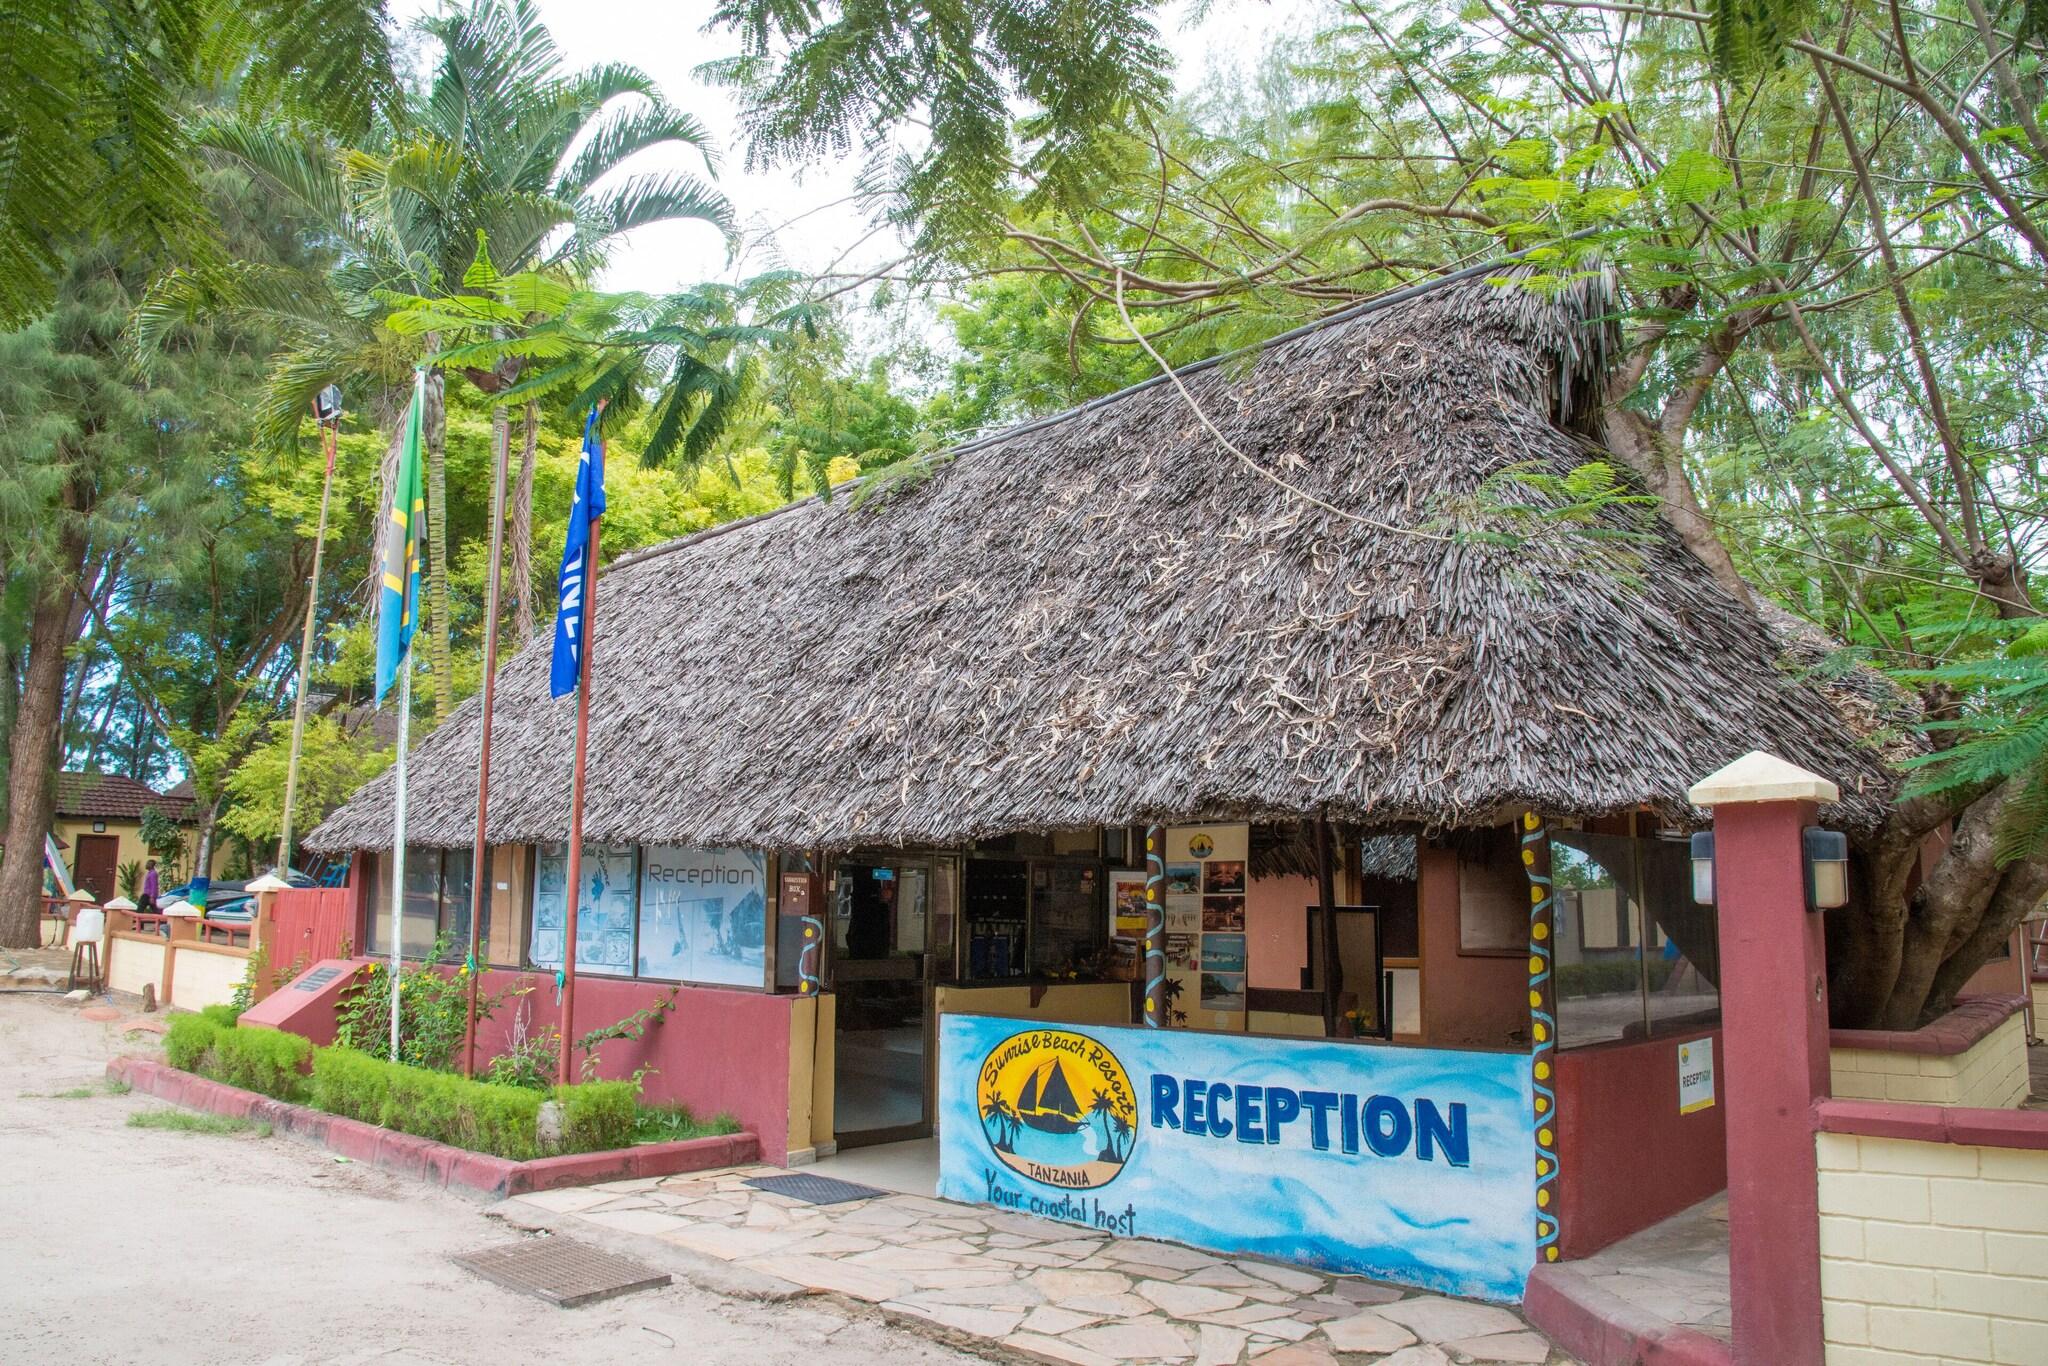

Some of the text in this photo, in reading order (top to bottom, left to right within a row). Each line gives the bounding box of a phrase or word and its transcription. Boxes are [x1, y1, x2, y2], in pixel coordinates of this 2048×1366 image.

[648, 863, 755, 888] Reception
[984, 1031, 1135, 1116] Sunrise Beach Resort
[1683, 1070, 1711, 1088] RECEPTION
[1150, 1073, 1470, 1168] RECEPTION
[1028, 1162, 1090, 1186] TANZANIA
[985, 1168, 1137, 1236] Your coastal host
